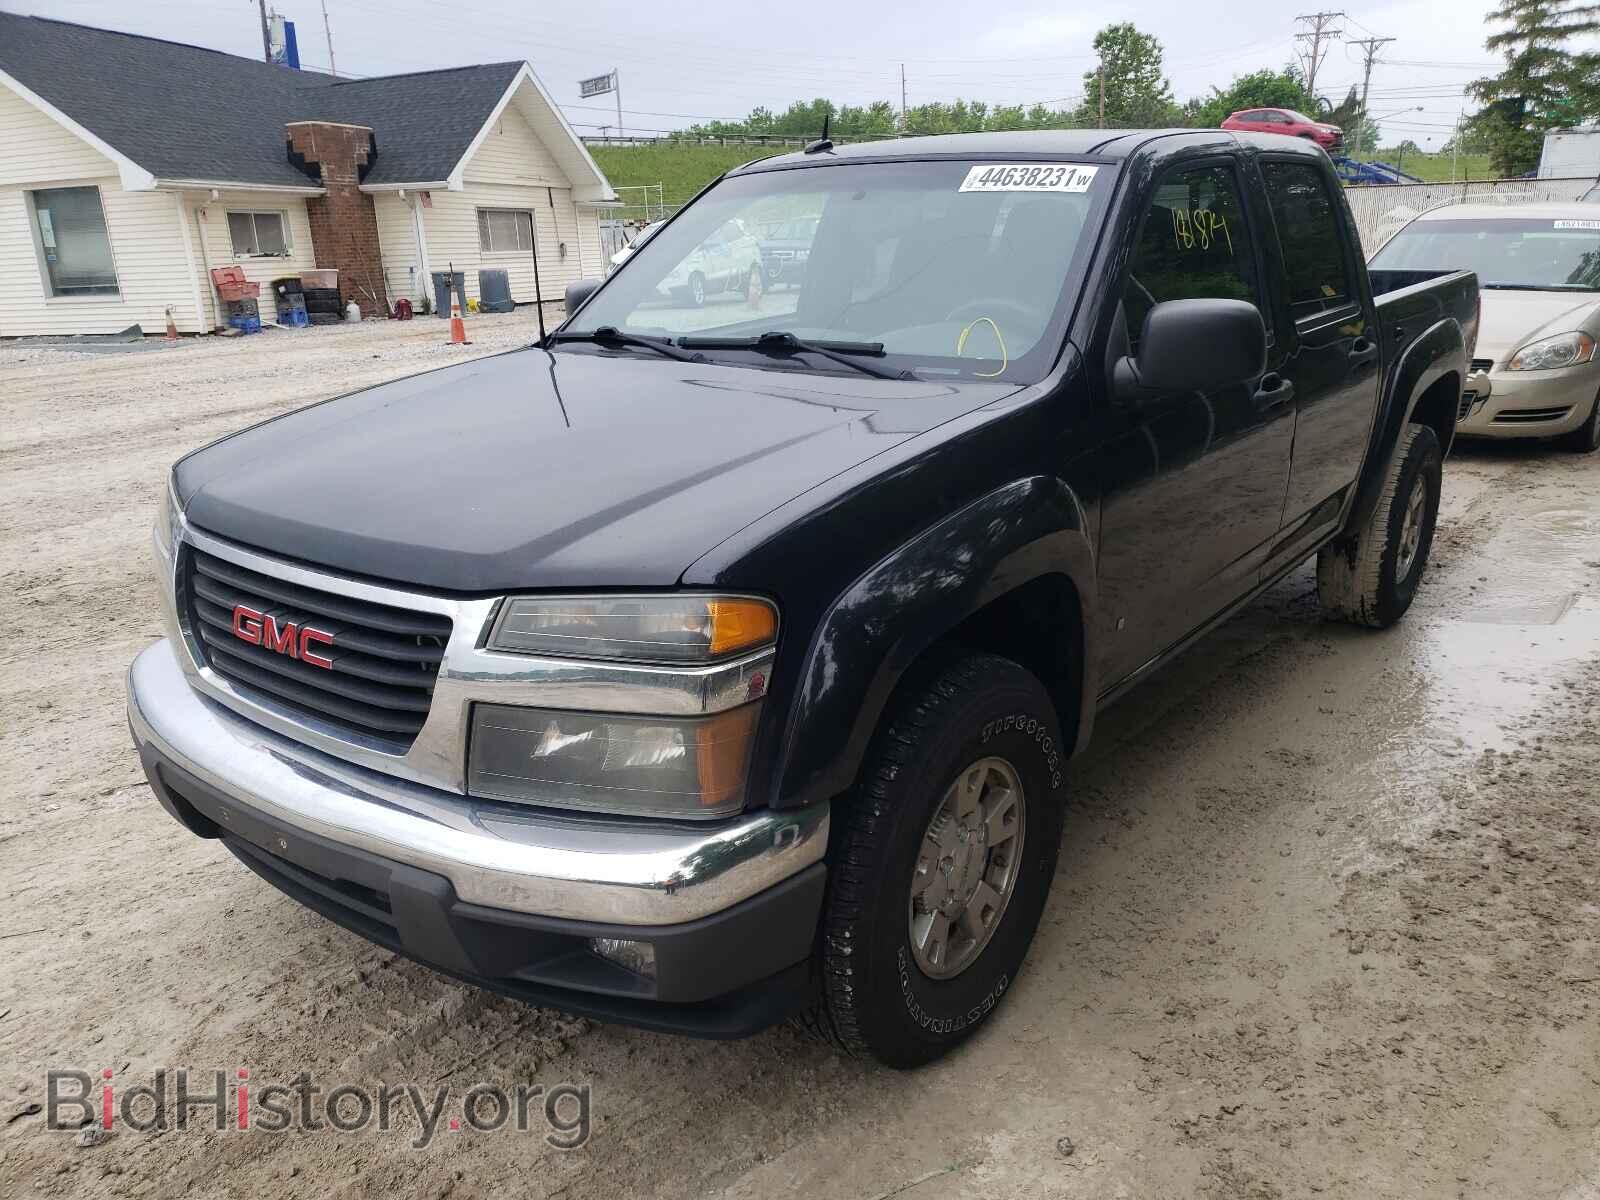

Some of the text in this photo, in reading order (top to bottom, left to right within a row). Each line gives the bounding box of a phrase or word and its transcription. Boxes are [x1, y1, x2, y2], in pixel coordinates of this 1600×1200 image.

[978, 166, 1078, 188] 44638231
[232, 604, 336, 670] GMC
[896, 945, 1009, 1033] DESTINATION
